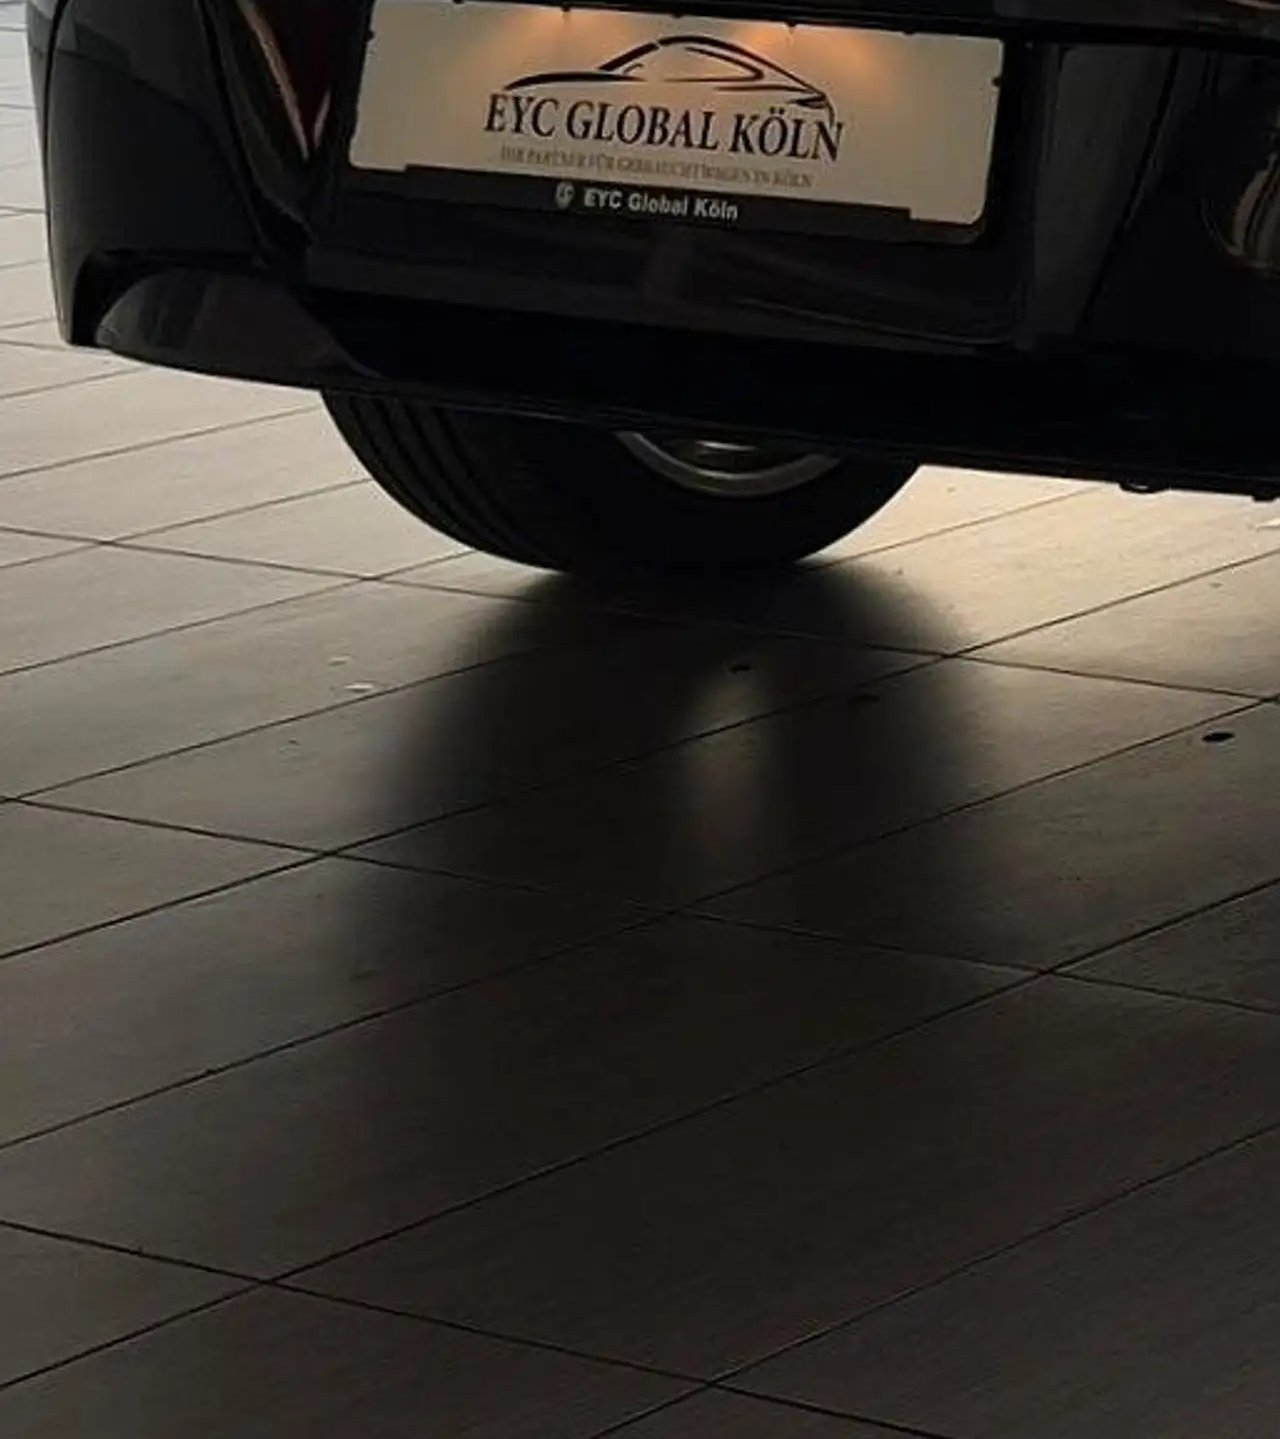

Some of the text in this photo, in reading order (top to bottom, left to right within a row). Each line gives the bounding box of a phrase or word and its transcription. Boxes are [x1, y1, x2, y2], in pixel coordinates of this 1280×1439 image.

[484, 93, 845, 161] EYC GLOBAL KÖLN
[583, 188, 739, 221] EYC Global Köln
